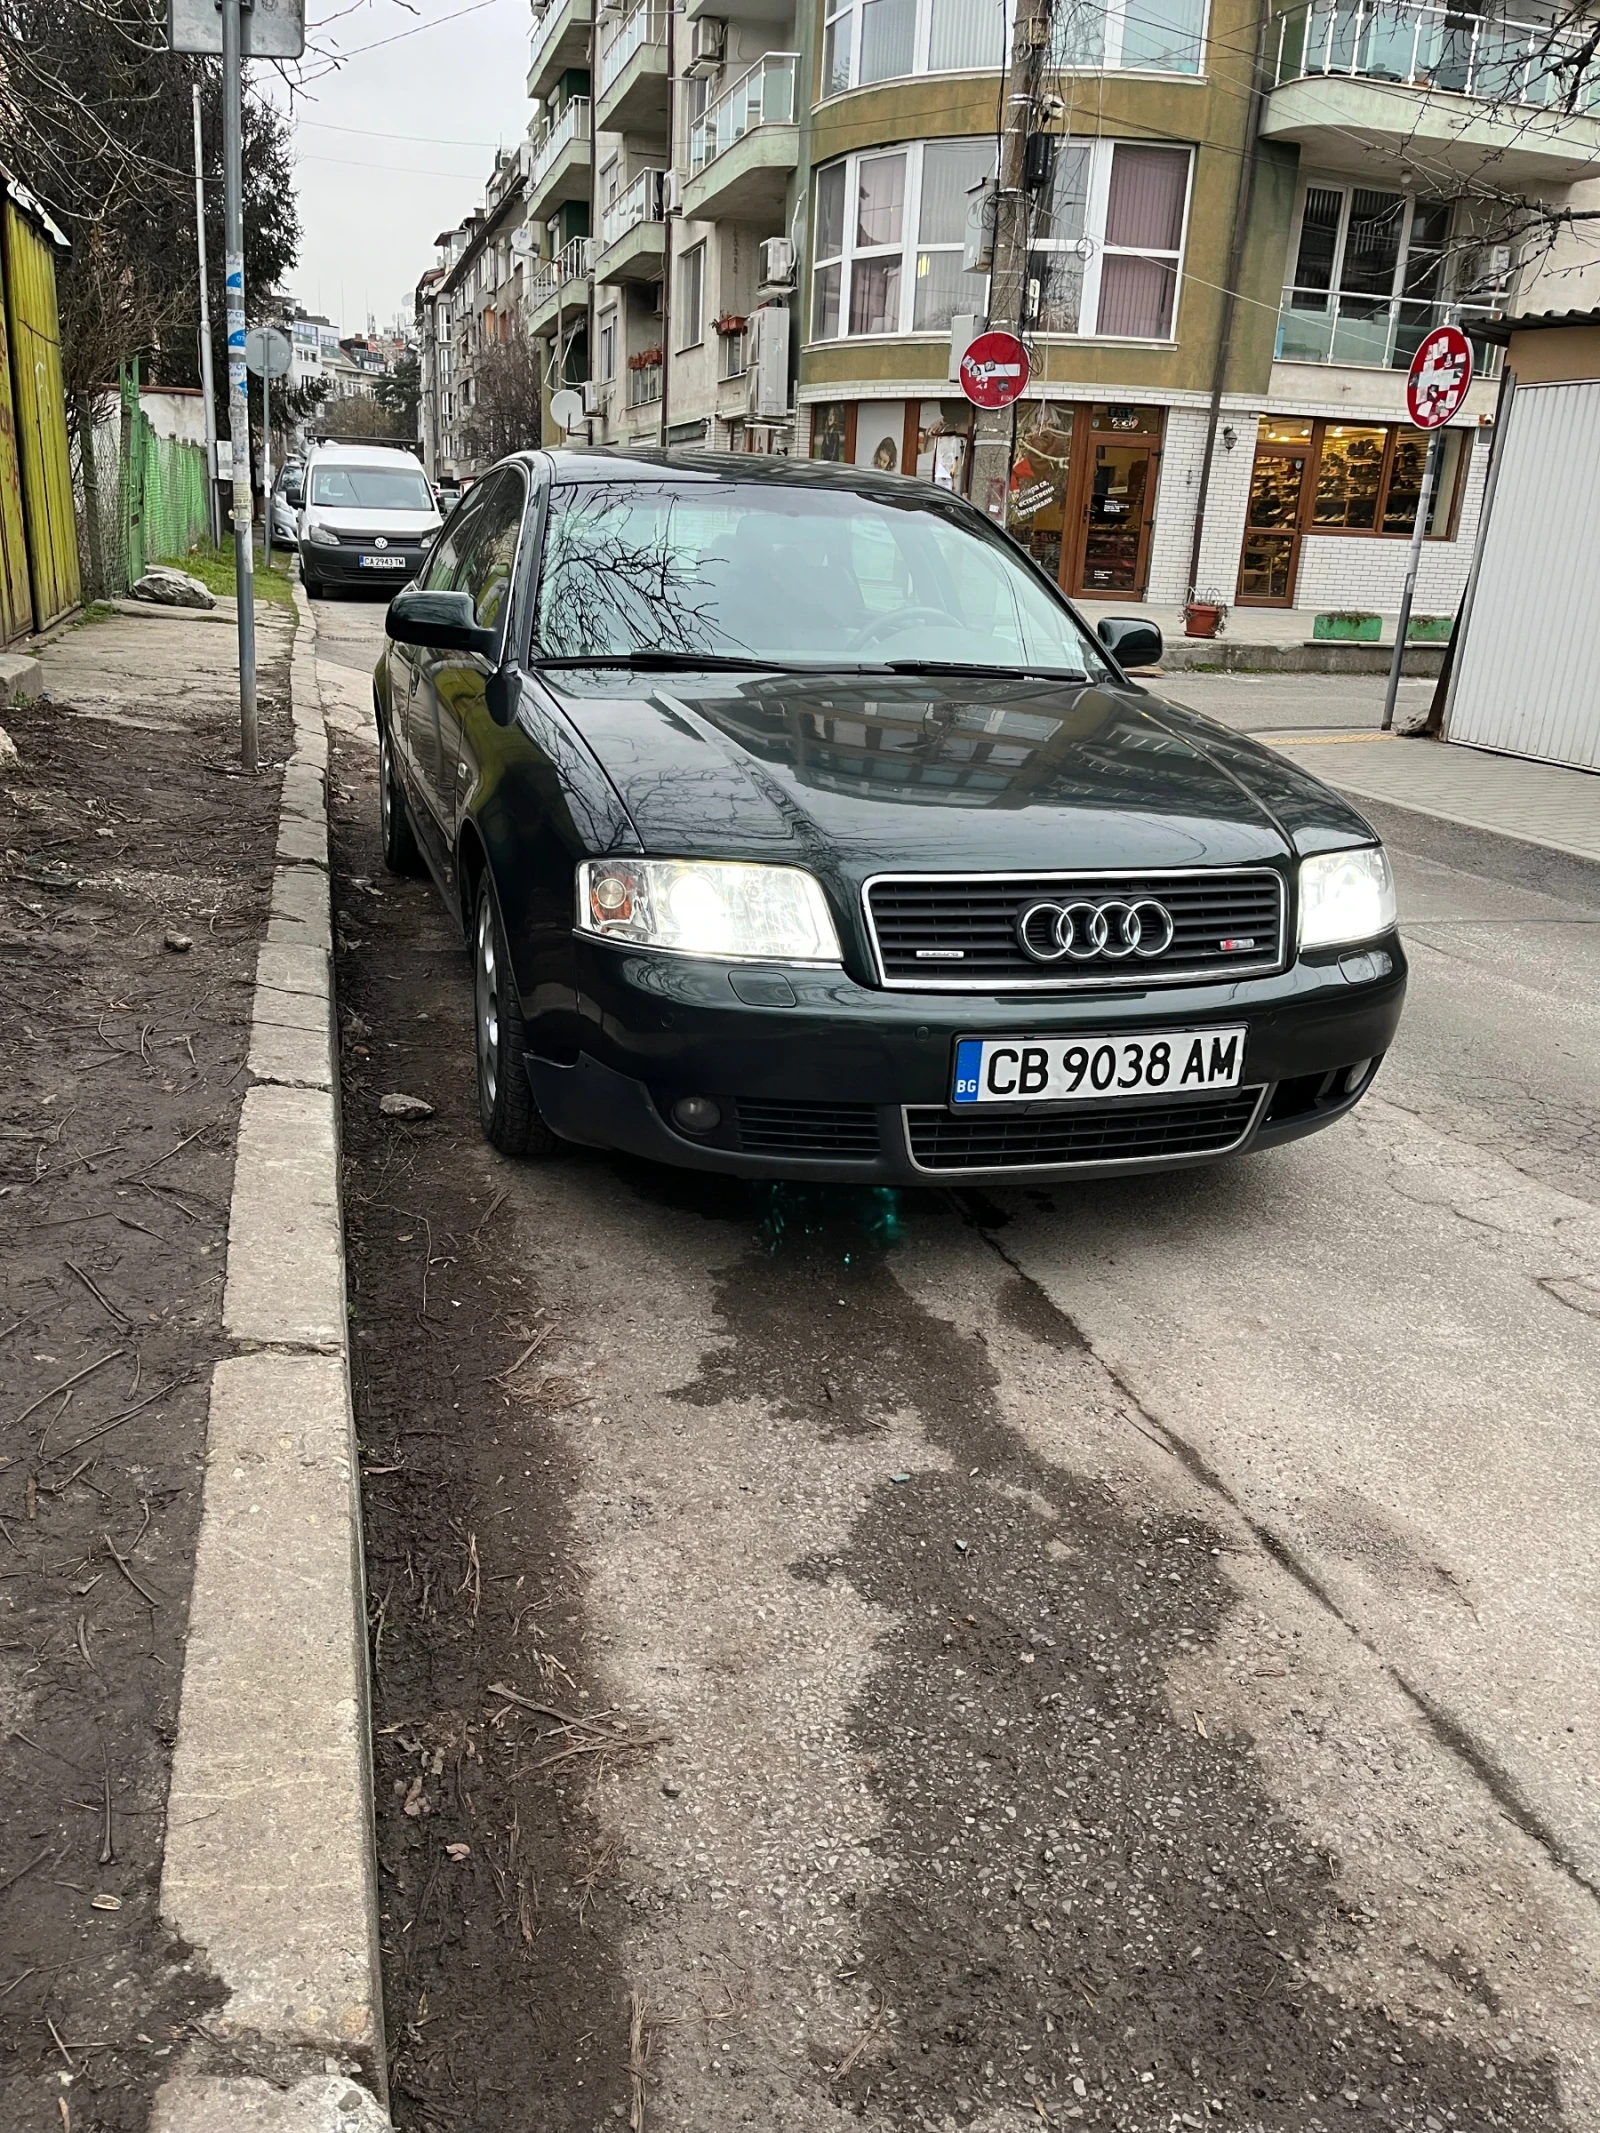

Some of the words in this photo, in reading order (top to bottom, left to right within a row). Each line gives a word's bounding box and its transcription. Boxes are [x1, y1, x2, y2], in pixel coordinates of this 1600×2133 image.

[1110, 408, 1131, 416] EXIT
[1018, 485, 1055, 507] естествени
[364, 558, 374, 566] CA
[956, 1079, 977, 1093] BG
[986, 1047, 1049, 1095] CB
[1062, 1041, 1171, 1092] 9038
[1179, 1035, 1238, 1085] AM
